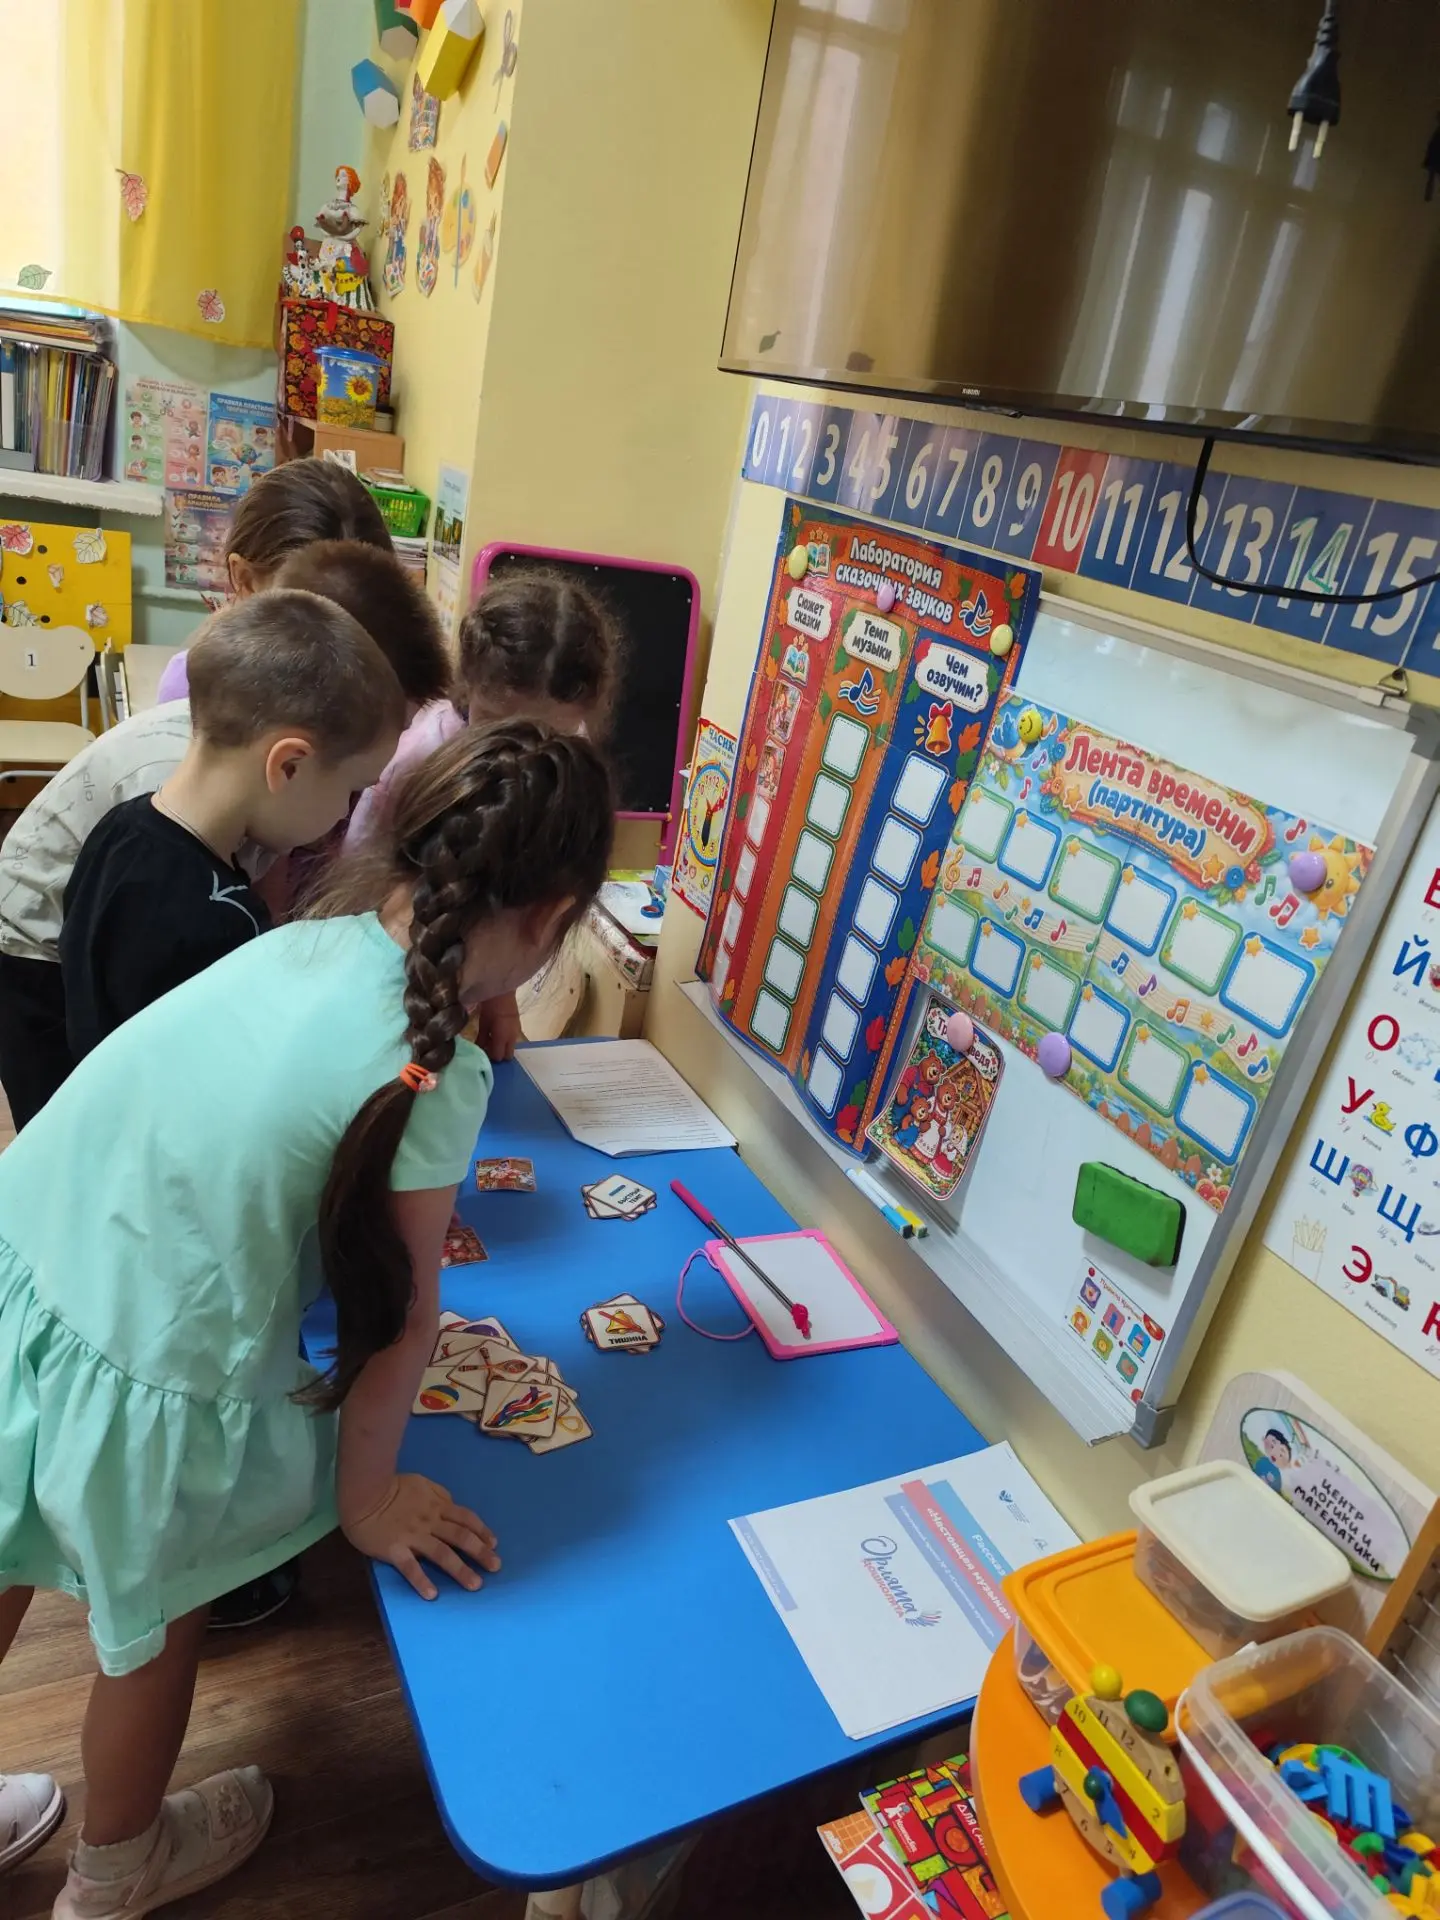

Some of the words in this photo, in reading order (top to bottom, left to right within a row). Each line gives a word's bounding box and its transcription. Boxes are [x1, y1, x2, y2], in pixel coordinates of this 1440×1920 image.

[752, 411, 769, 468] 0
[776, 415, 791, 474] 1
[792, 419, 812, 479] 2
[816, 424, 841, 486] 3
[849, 430, 870, 493] 4
[870, 436, 899, 500] 5
[905, 442, 932, 510] 6
[936, 448, 968, 517] 7
[972, 455, 1003, 528] 8
[1008, 462, 1043, 536] 9
[1047, 471, 1096, 553] 10
[1095, 479, 1144, 566] 11
[1149, 491, 1209, 583] 12
[1211, 503, 1275, 597] 13
[1276, 516, 1354, 618] 14
[1350, 532, 1439, 637] 15
[850, 537, 943, 590] Лаборатория
[794, 608, 822, 632] сказки
[797, 593, 825, 616] Сюжет
[906, 587, 954, 624] звуков
[864, 619, 890, 644] Темп
[28, 653, 36, 667] 1
[852, 634, 892, 662] музыки
[946, 654, 969, 678] Чем
[926, 669, 983, 704] озвучим?
[709, 727, 736, 753] ЧАСИК
[1064, 735, 1145, 789] Лента
[1147, 768, 1257, 854] времени
[1088, 779, 1207, 857] (партитура)
[1392, 934, 1432, 987] Й
[1367, 1014, 1400, 1051] О
[1341, 1076, 1375, 1114] У
[1404, 1121, 1439, 1159] Ф
[1309, 1138, 1351, 1186] Ш
[1377, 1184, 1422, 1243] Щ
[1342, 1245, 1373, 1283] Э
[608, 1335, 648, 1345] ТИШИНА
[1321, 1478, 1365, 1521] ЦЕНТР
[1294, 1485, 1381, 1572] МАТЕМАТИКИ
[1310, 1485, 1358, 1535] ЛОГИКИ
[1362, 1531, 1372, 1548] И
[861, 1535, 918, 1614] Орлята
[1073, 1704, 1087, 1724] 10
[1100, 1710, 1109, 1728] 11
[1121, 1729, 1135, 1750] 12
[1062, 1782, 1070, 1794] 7
[956, 1804, 977, 1826] ДЛЯ
[1080, 1819, 1088, 1832] 6
[1152, 1808, 1160, 1821] 2
